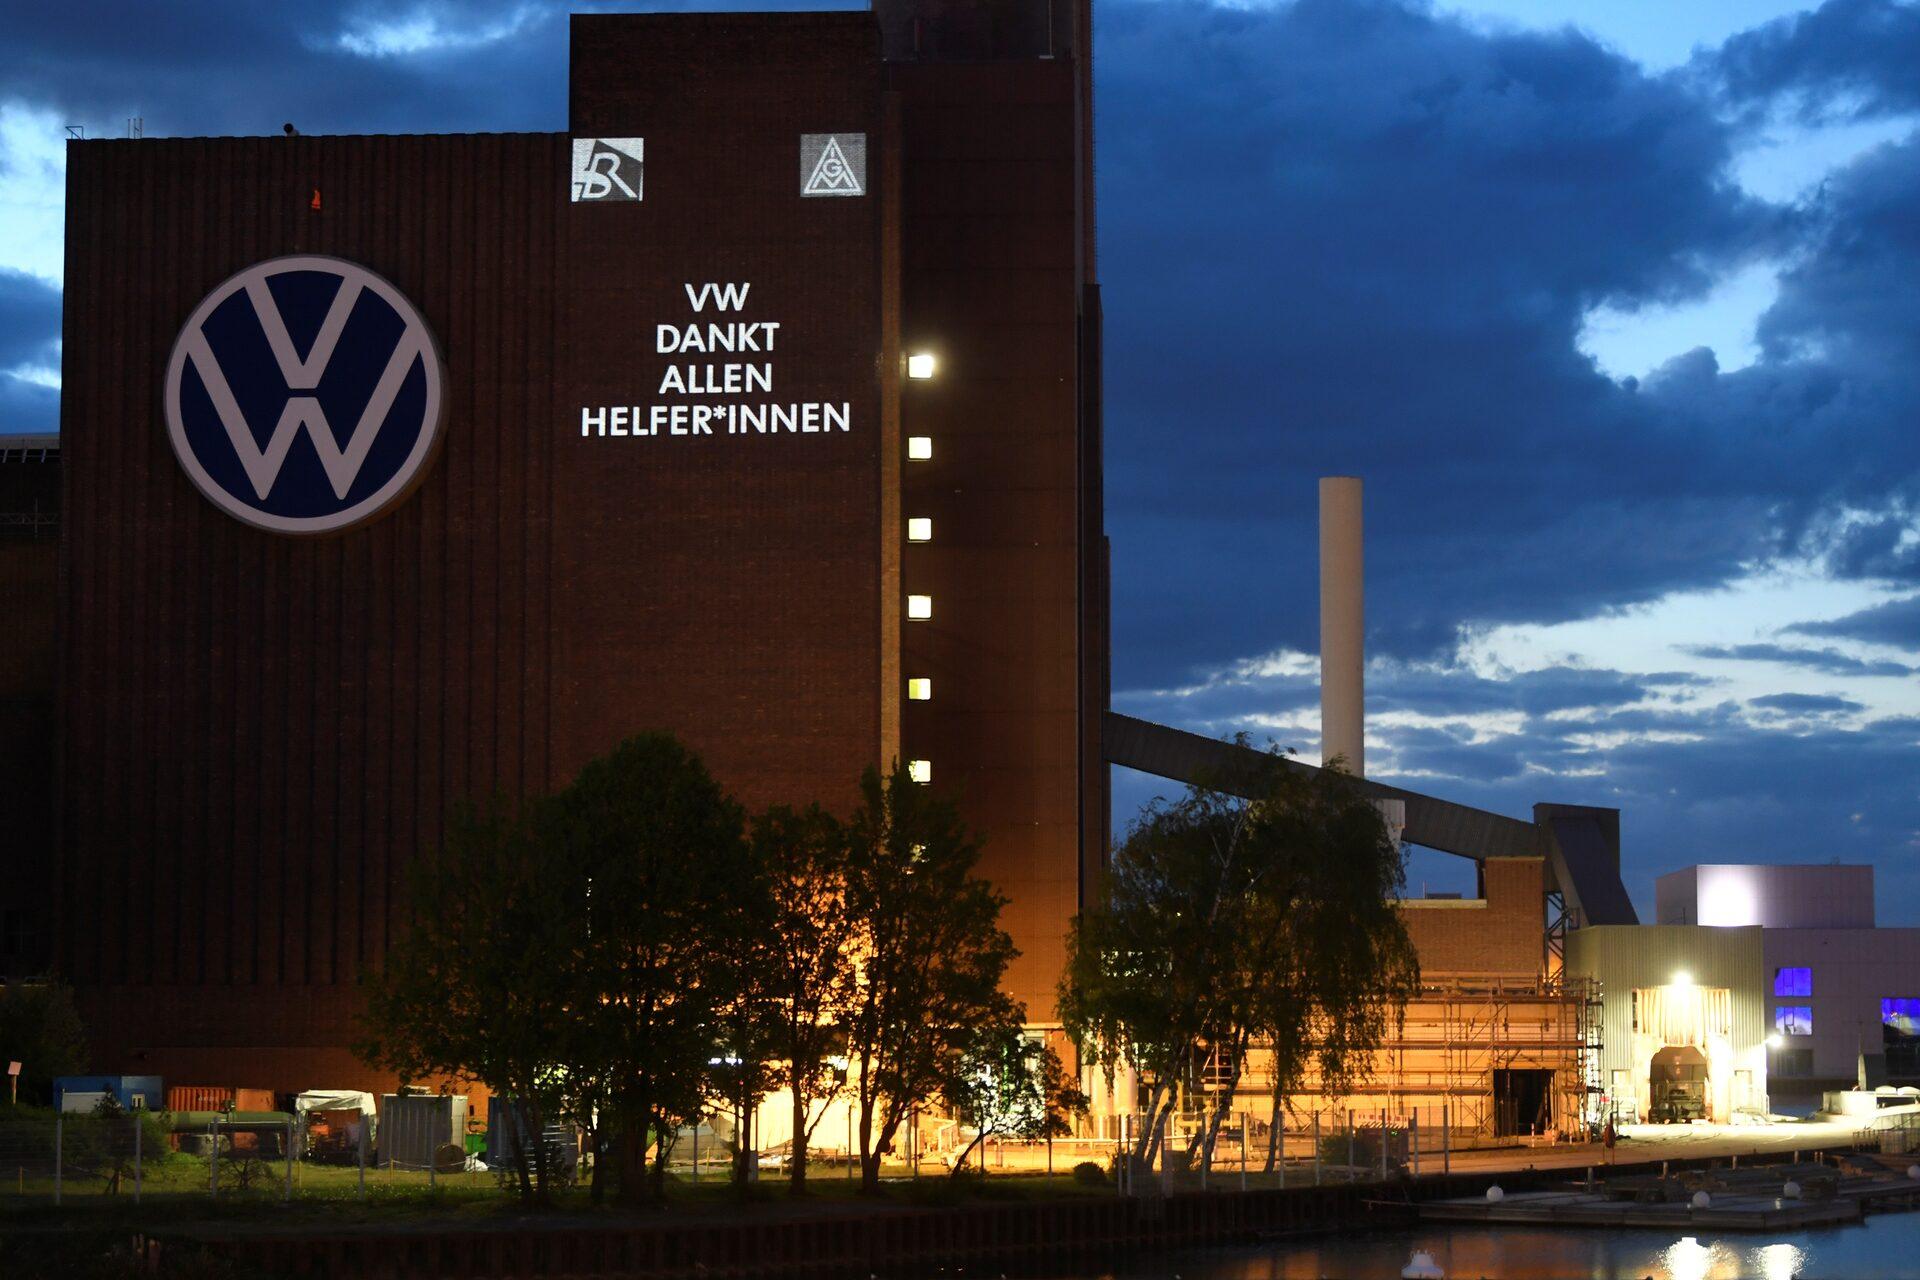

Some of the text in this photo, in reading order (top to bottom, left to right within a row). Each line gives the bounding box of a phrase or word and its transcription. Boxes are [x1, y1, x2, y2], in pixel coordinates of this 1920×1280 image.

[684, 281, 751, 313] VW
[656, 321, 781, 354] DANKT
[176, 262, 430, 503] VW
[658, 362, 773, 395] ALLEN
